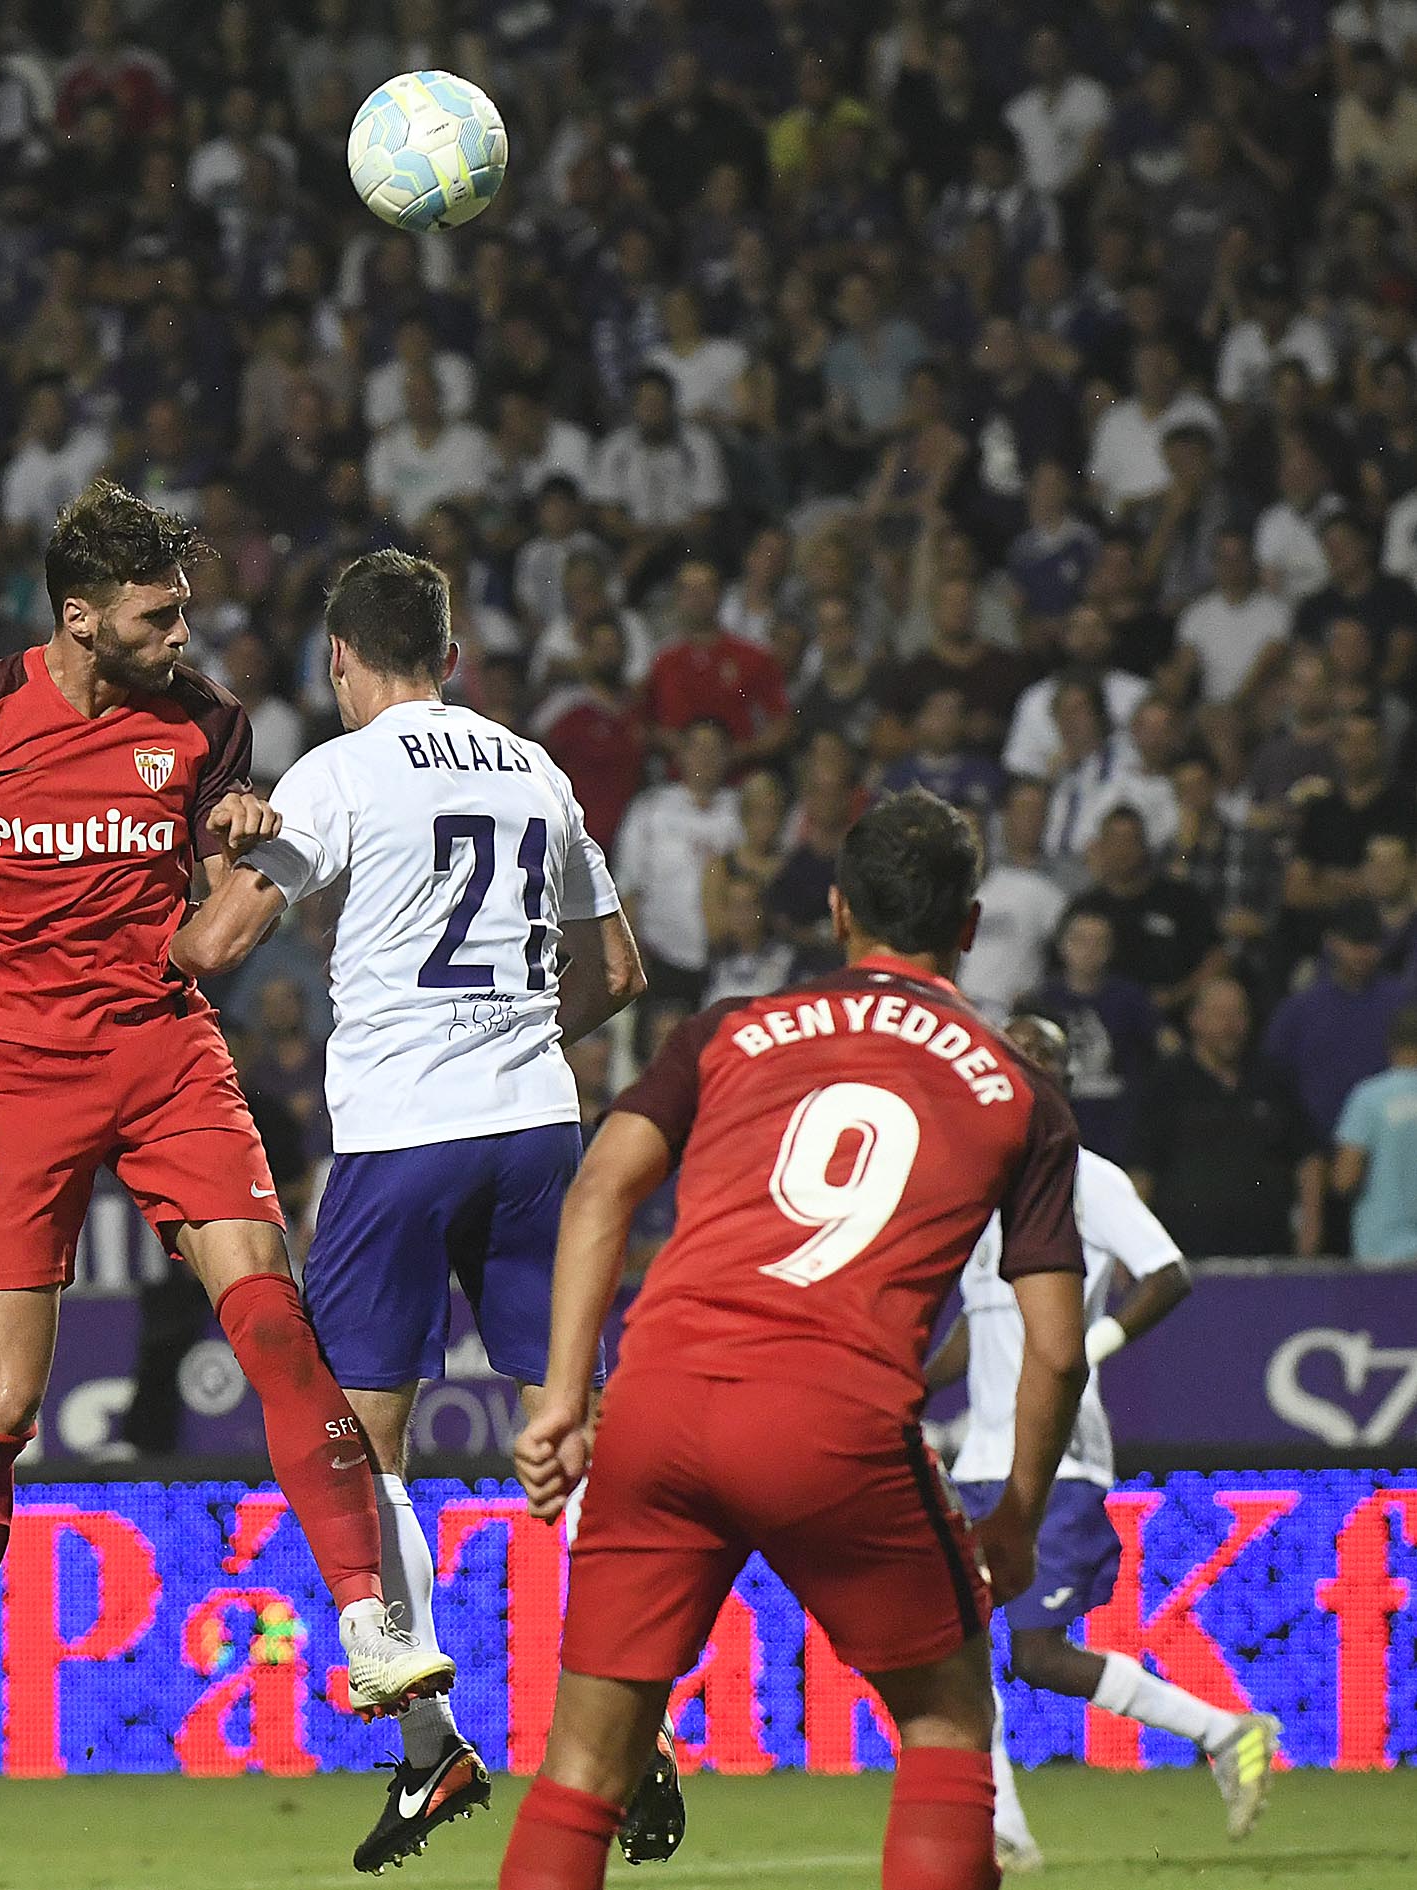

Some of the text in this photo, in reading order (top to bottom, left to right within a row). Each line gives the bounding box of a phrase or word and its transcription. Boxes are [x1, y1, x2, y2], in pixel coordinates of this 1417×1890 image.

[398, 730, 532, 773] BALÁZS
[417, 815, 547, 991] 21
[462, 988, 516, 1003] update
[732, 994, 1015, 1106] BEN YEDDER
[758, 1082, 920, 1288] 9
[325, 1416, 358, 1438] SFC
